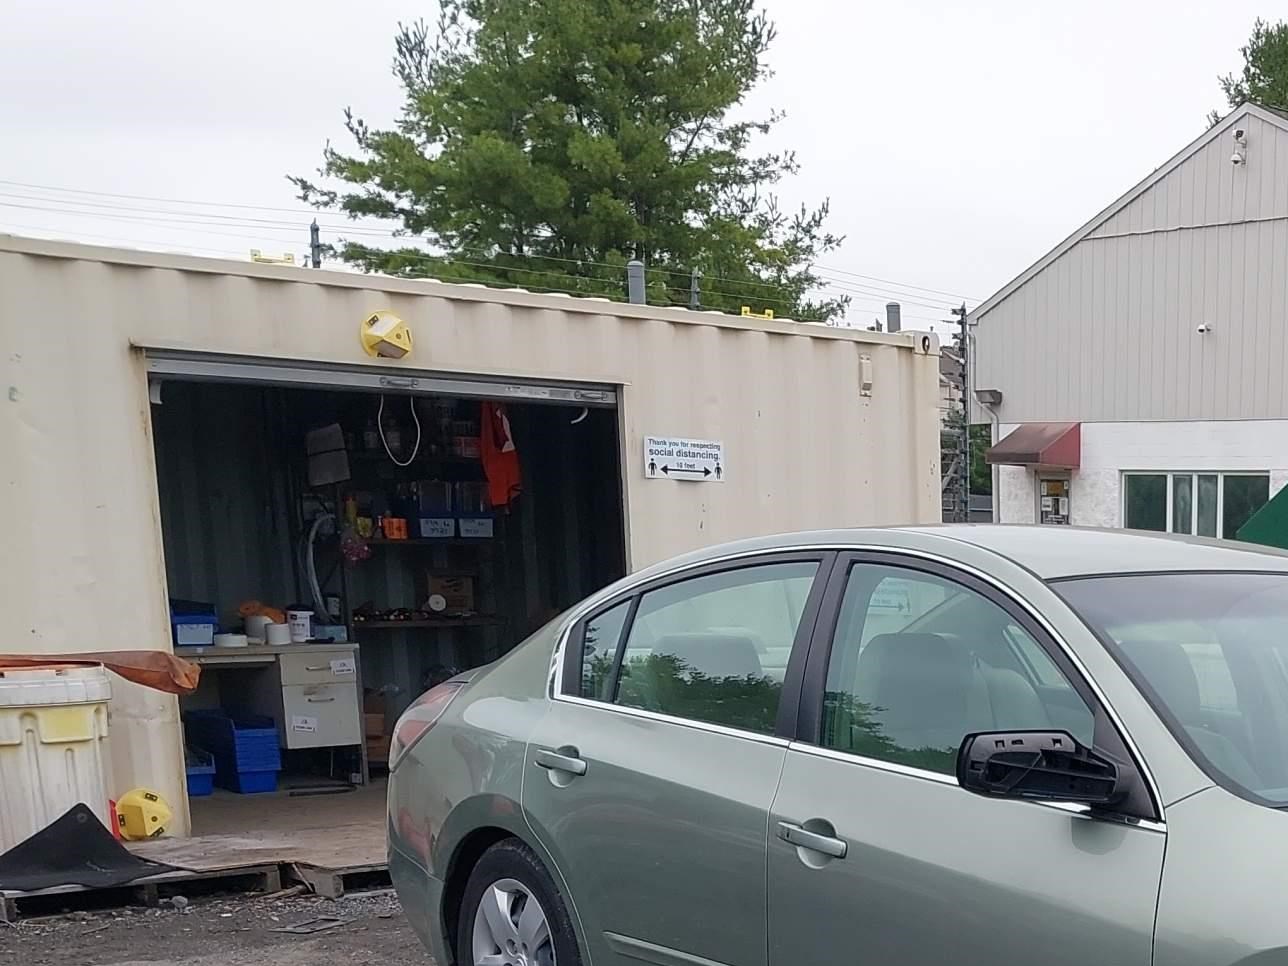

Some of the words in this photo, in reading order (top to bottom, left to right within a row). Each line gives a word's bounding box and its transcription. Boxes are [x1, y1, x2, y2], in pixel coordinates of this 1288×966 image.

[648, 438, 667, 446] Thank
[680, 440, 689, 448] for
[649, 448, 674, 457] social
[676, 449, 721, 462] distancing.
